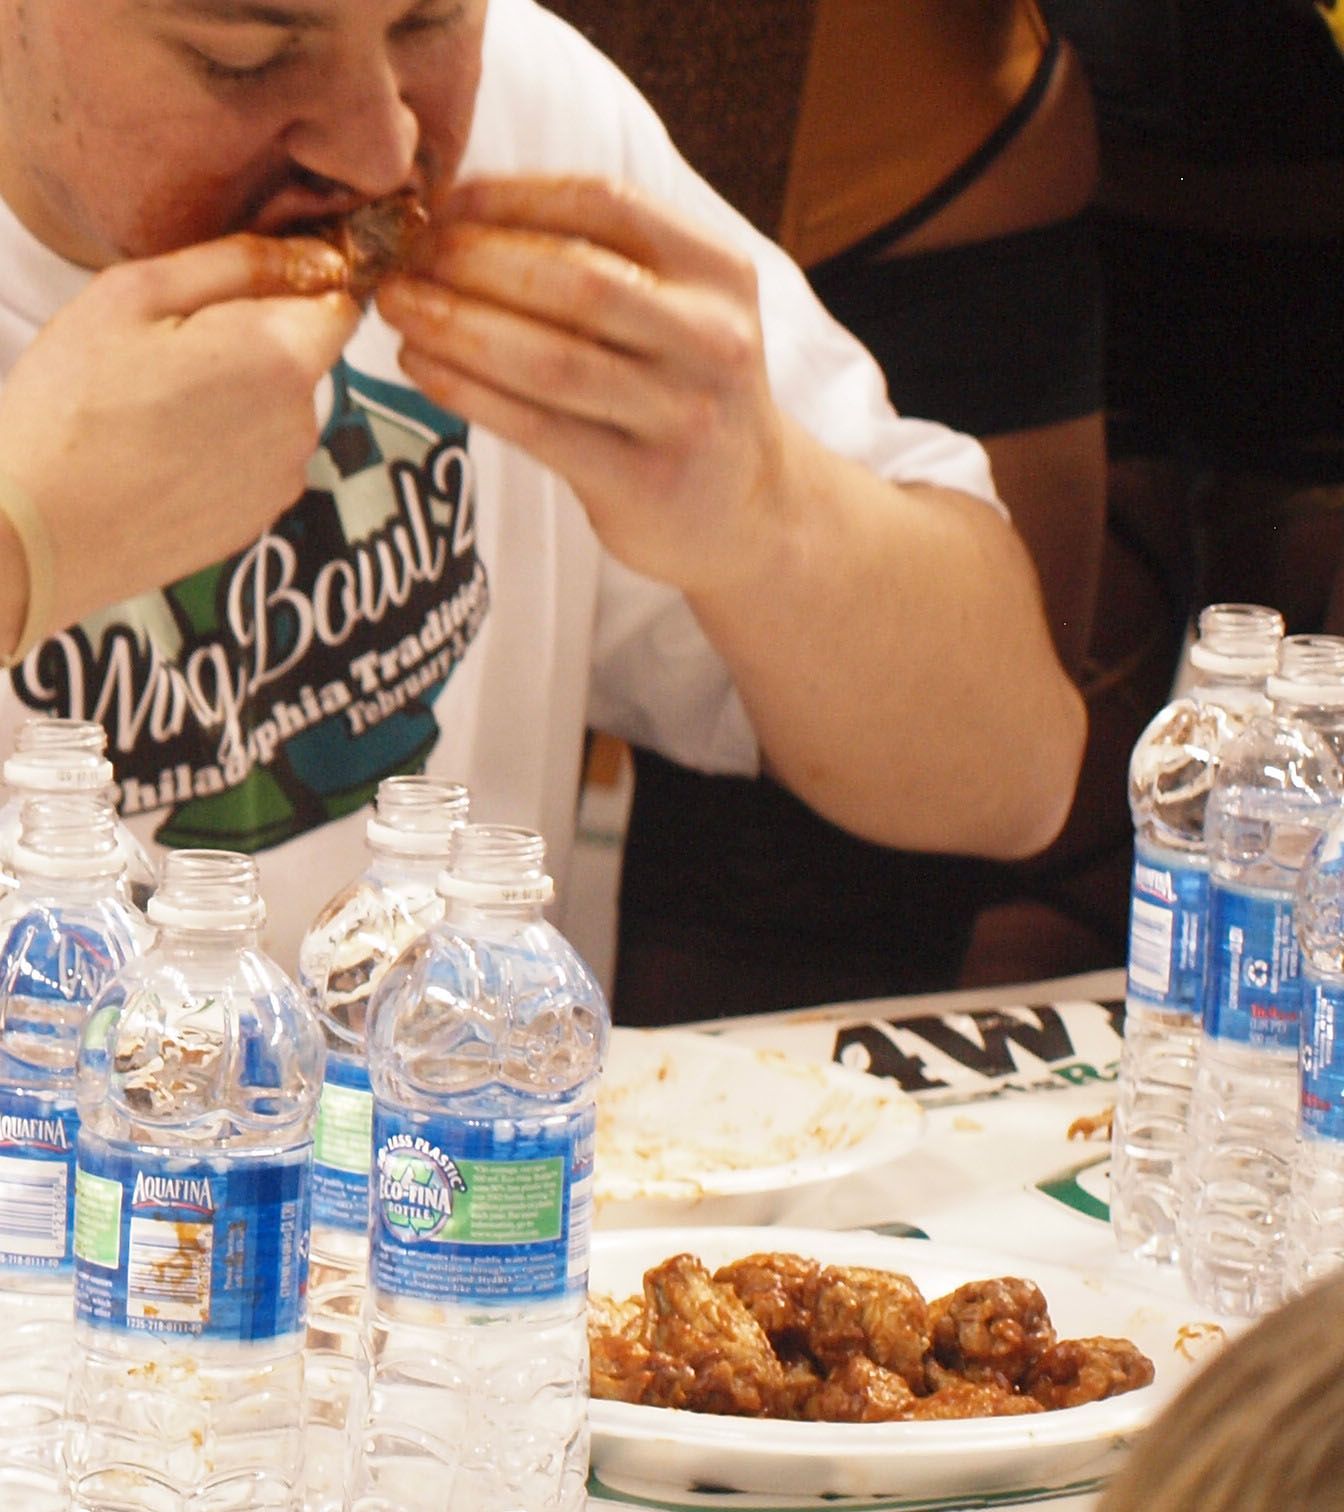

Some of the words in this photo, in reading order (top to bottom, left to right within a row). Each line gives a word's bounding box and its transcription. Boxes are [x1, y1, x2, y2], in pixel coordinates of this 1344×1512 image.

[227, 470, 447, 695] Bowl
[387, 1133, 414, 1149] LESS
[132, 1171, 214, 1210] AQUAFINA
[379, 1174, 453, 1216] ECO-FINA
[388, 1202, 432, 1221] BOTTLE
